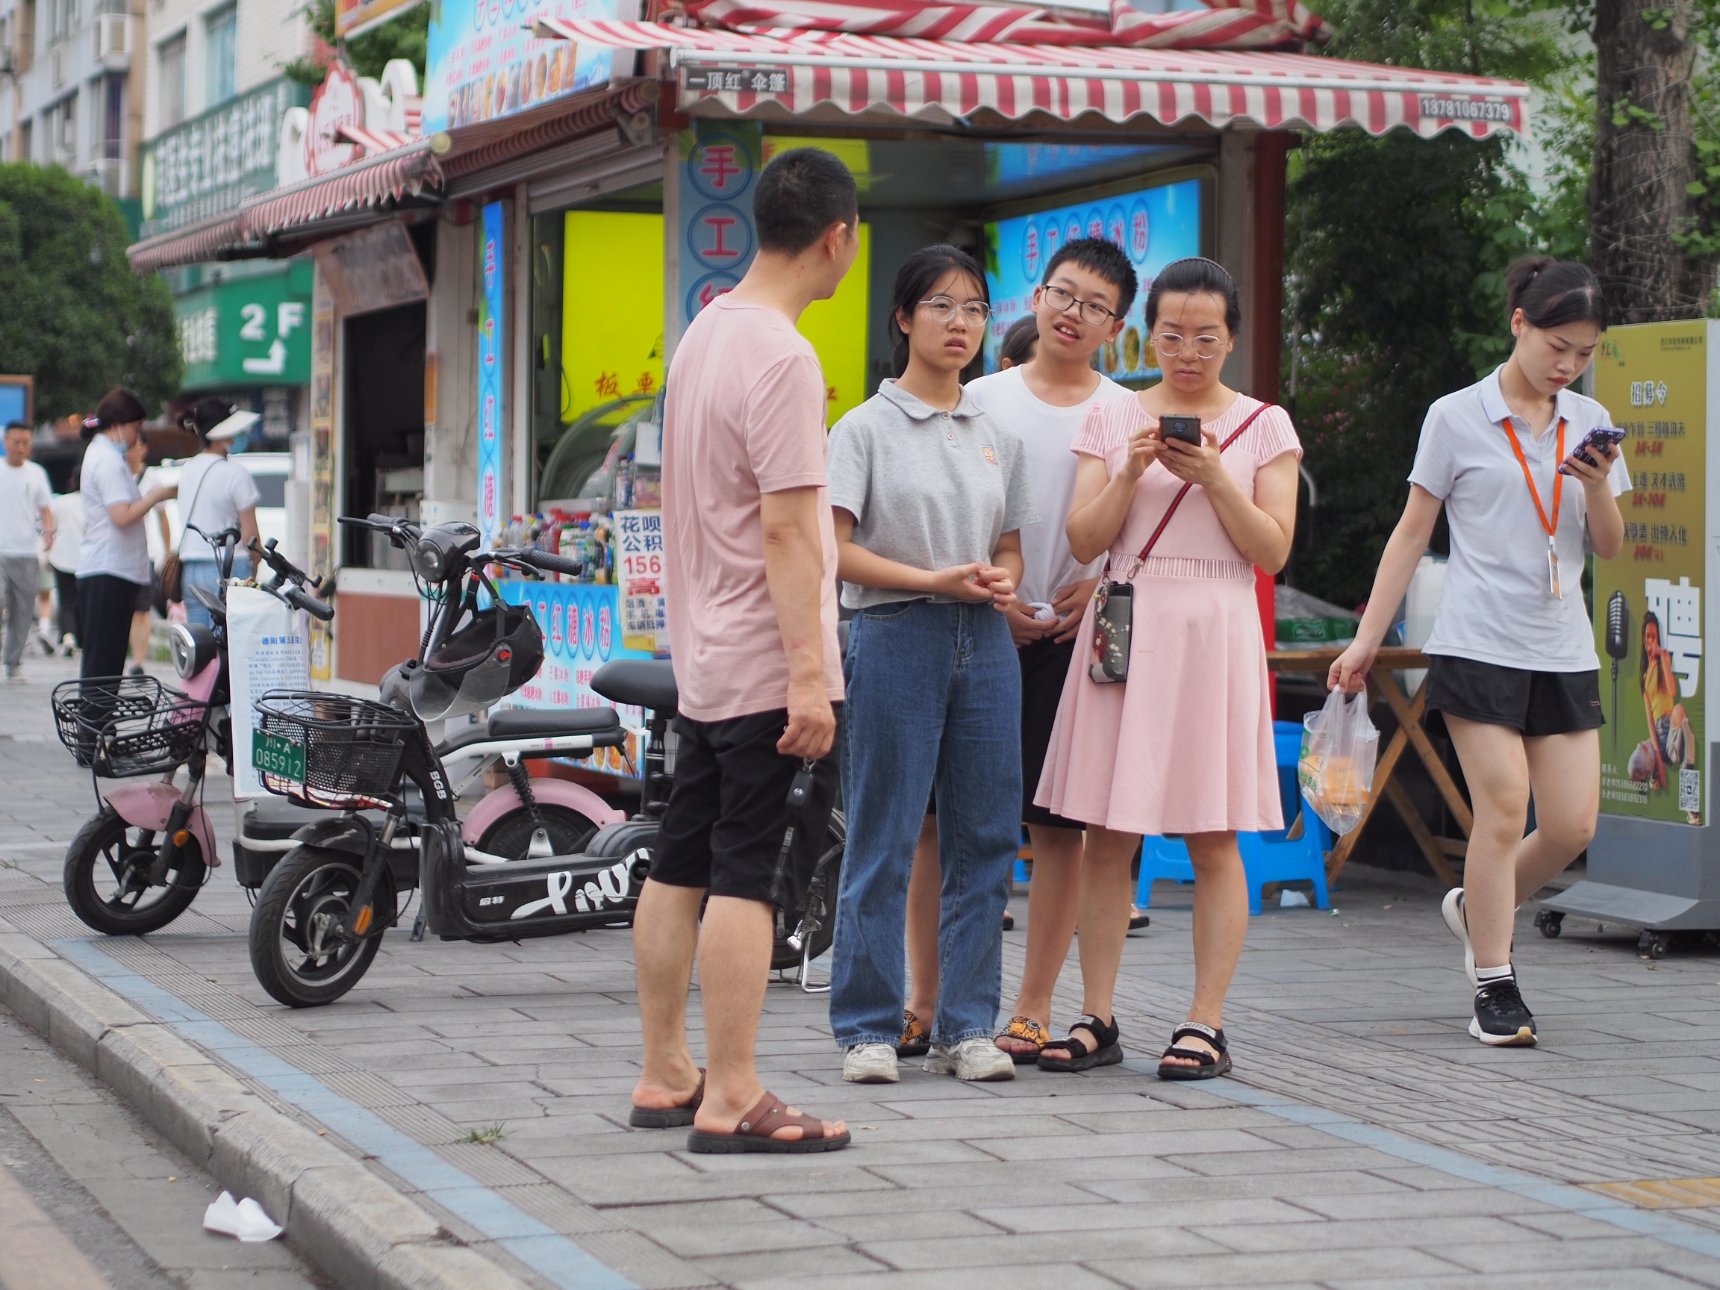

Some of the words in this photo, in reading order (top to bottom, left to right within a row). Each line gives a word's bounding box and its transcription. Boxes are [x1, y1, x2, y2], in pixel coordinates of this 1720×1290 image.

[1422, 99, 1510, 120] 18781067379
[239, 302, 305, 341] 2F
[483, 238, 496, 518] 手工红糖
[1631, 381, 1668, 405] 招募令
[620, 515, 661, 534] 花呗
[1651, 523, 1687, 545] 出神入化
[1645, 576, 1702, 698] 聘
[255, 747, 302, 778] 085912
[430, 770, 448, 800] BGB
